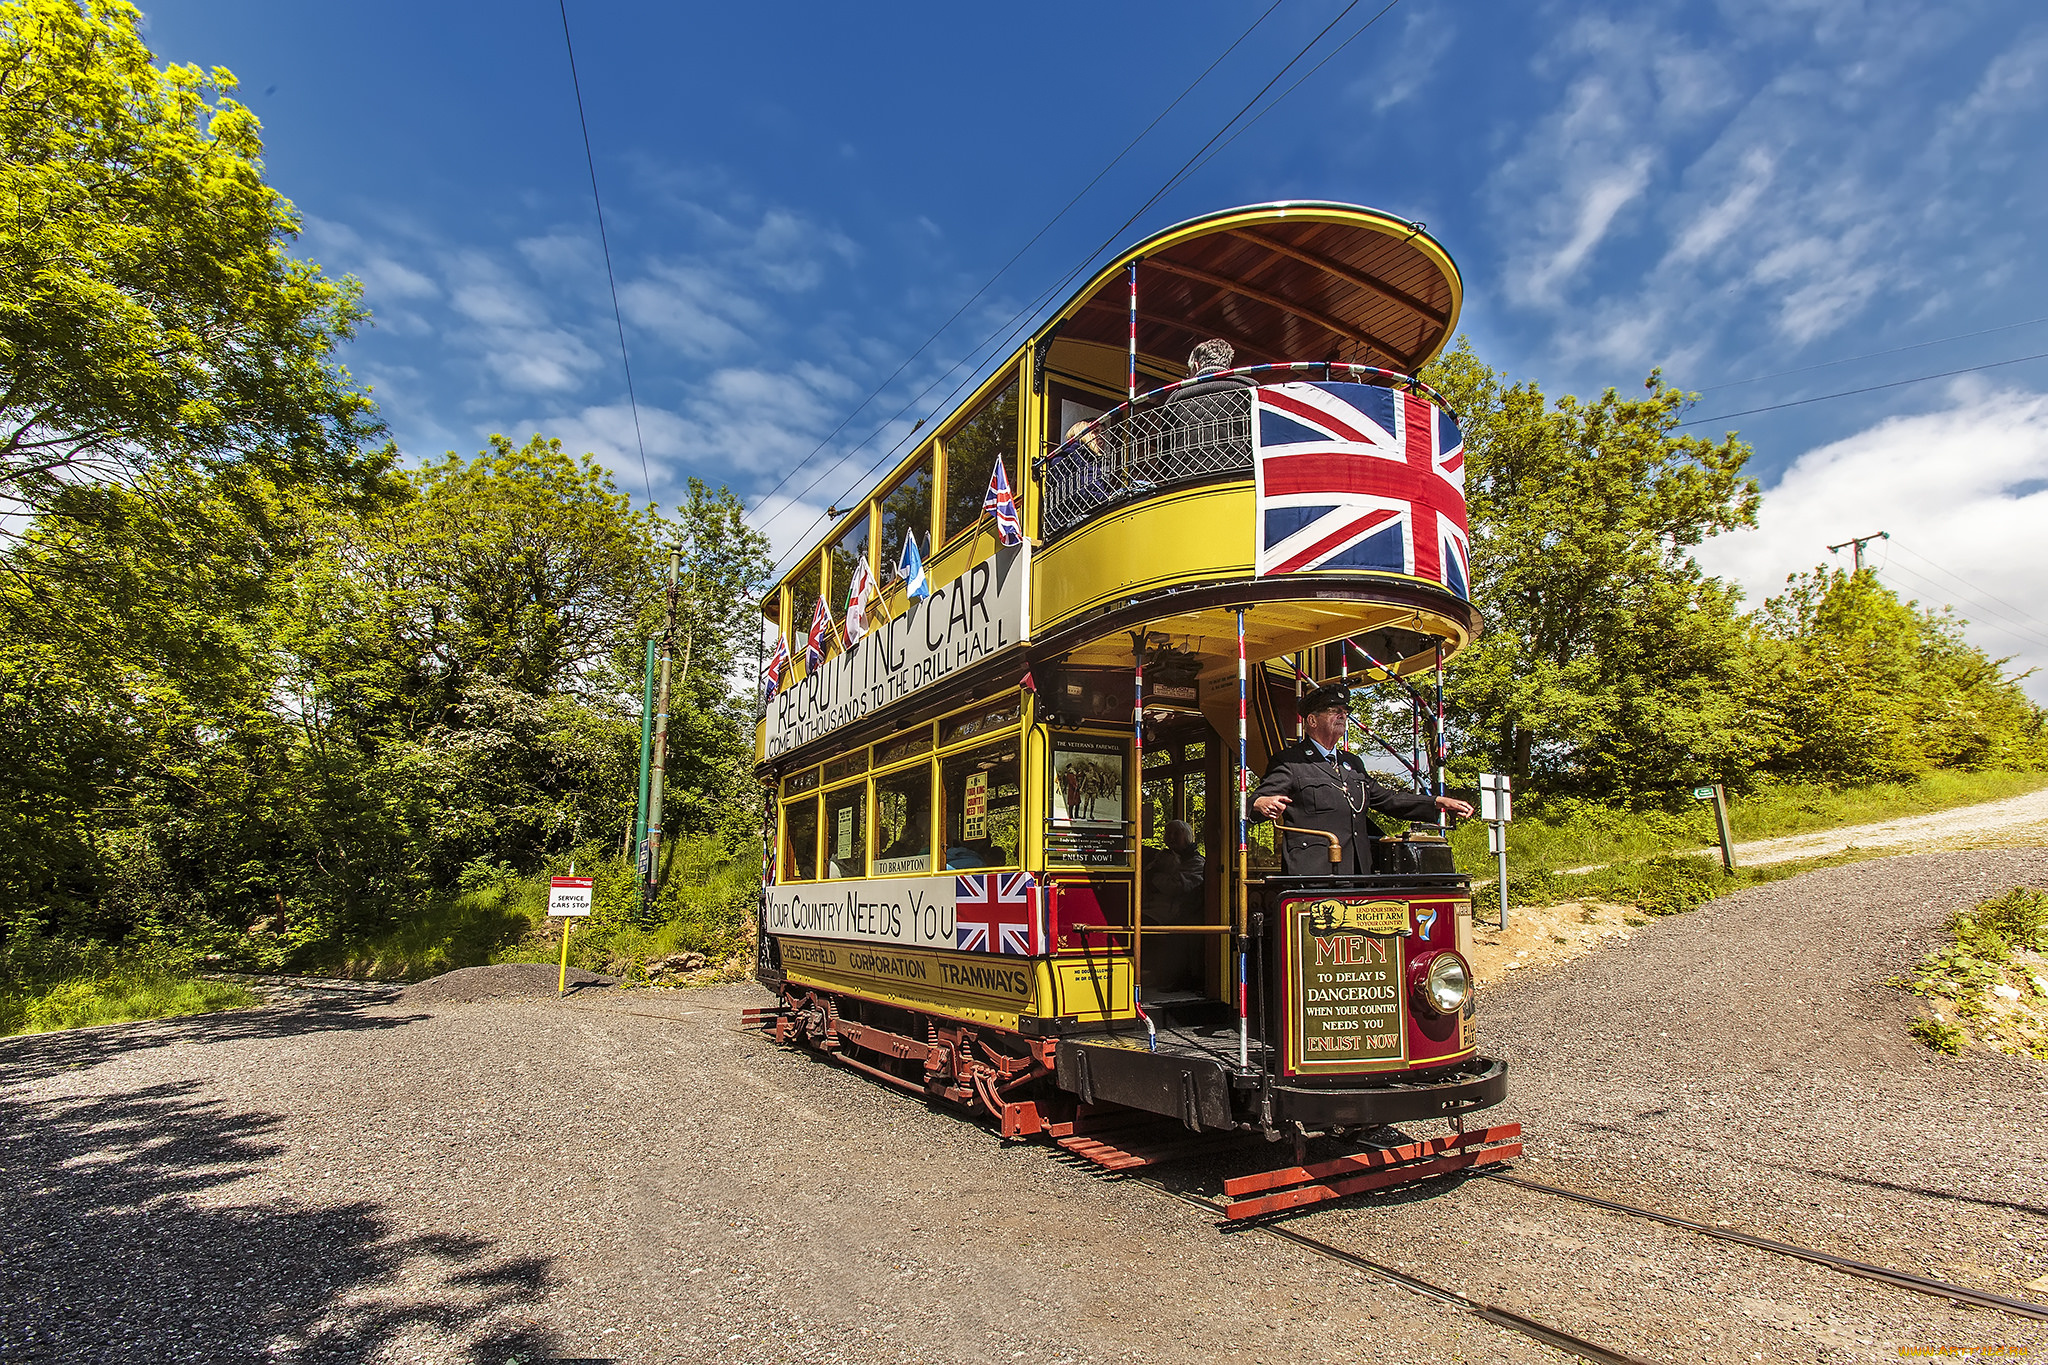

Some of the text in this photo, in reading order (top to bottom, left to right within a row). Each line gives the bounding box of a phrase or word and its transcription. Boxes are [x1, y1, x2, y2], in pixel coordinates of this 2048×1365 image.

[777, 560, 990, 734] RECRUITING CAR
[768, 618, 1008, 758] COME IN THOUSANDS TO THE DRILL HALL
[879, 858, 925, 873] TO BRAMPTON
[1062, 853, 1112, 862] ENLIST NOW!
[767, 889, 954, 943] YOUR COUNTRY NEEDS YOU
[1356, 912, 1404, 921] RIGHT ARM
[1415, 908, 1438, 942] 7
[1314, 935, 1388, 966] MEN
[782, 944, 1029, 995] CHESTERFIELD CORPORATION TRAMWAYS
[1317, 971, 1387, 983] TO DELAY IS
[1307, 985, 1396, 1002] DANGEROUS
[1306, 1003, 1398, 1017] WHEN YOUR COUNTRY
[1322, 1019, 1384, 1031] NEEDS YOU
[1307, 1033, 1399, 1052] ENLIST NOW
